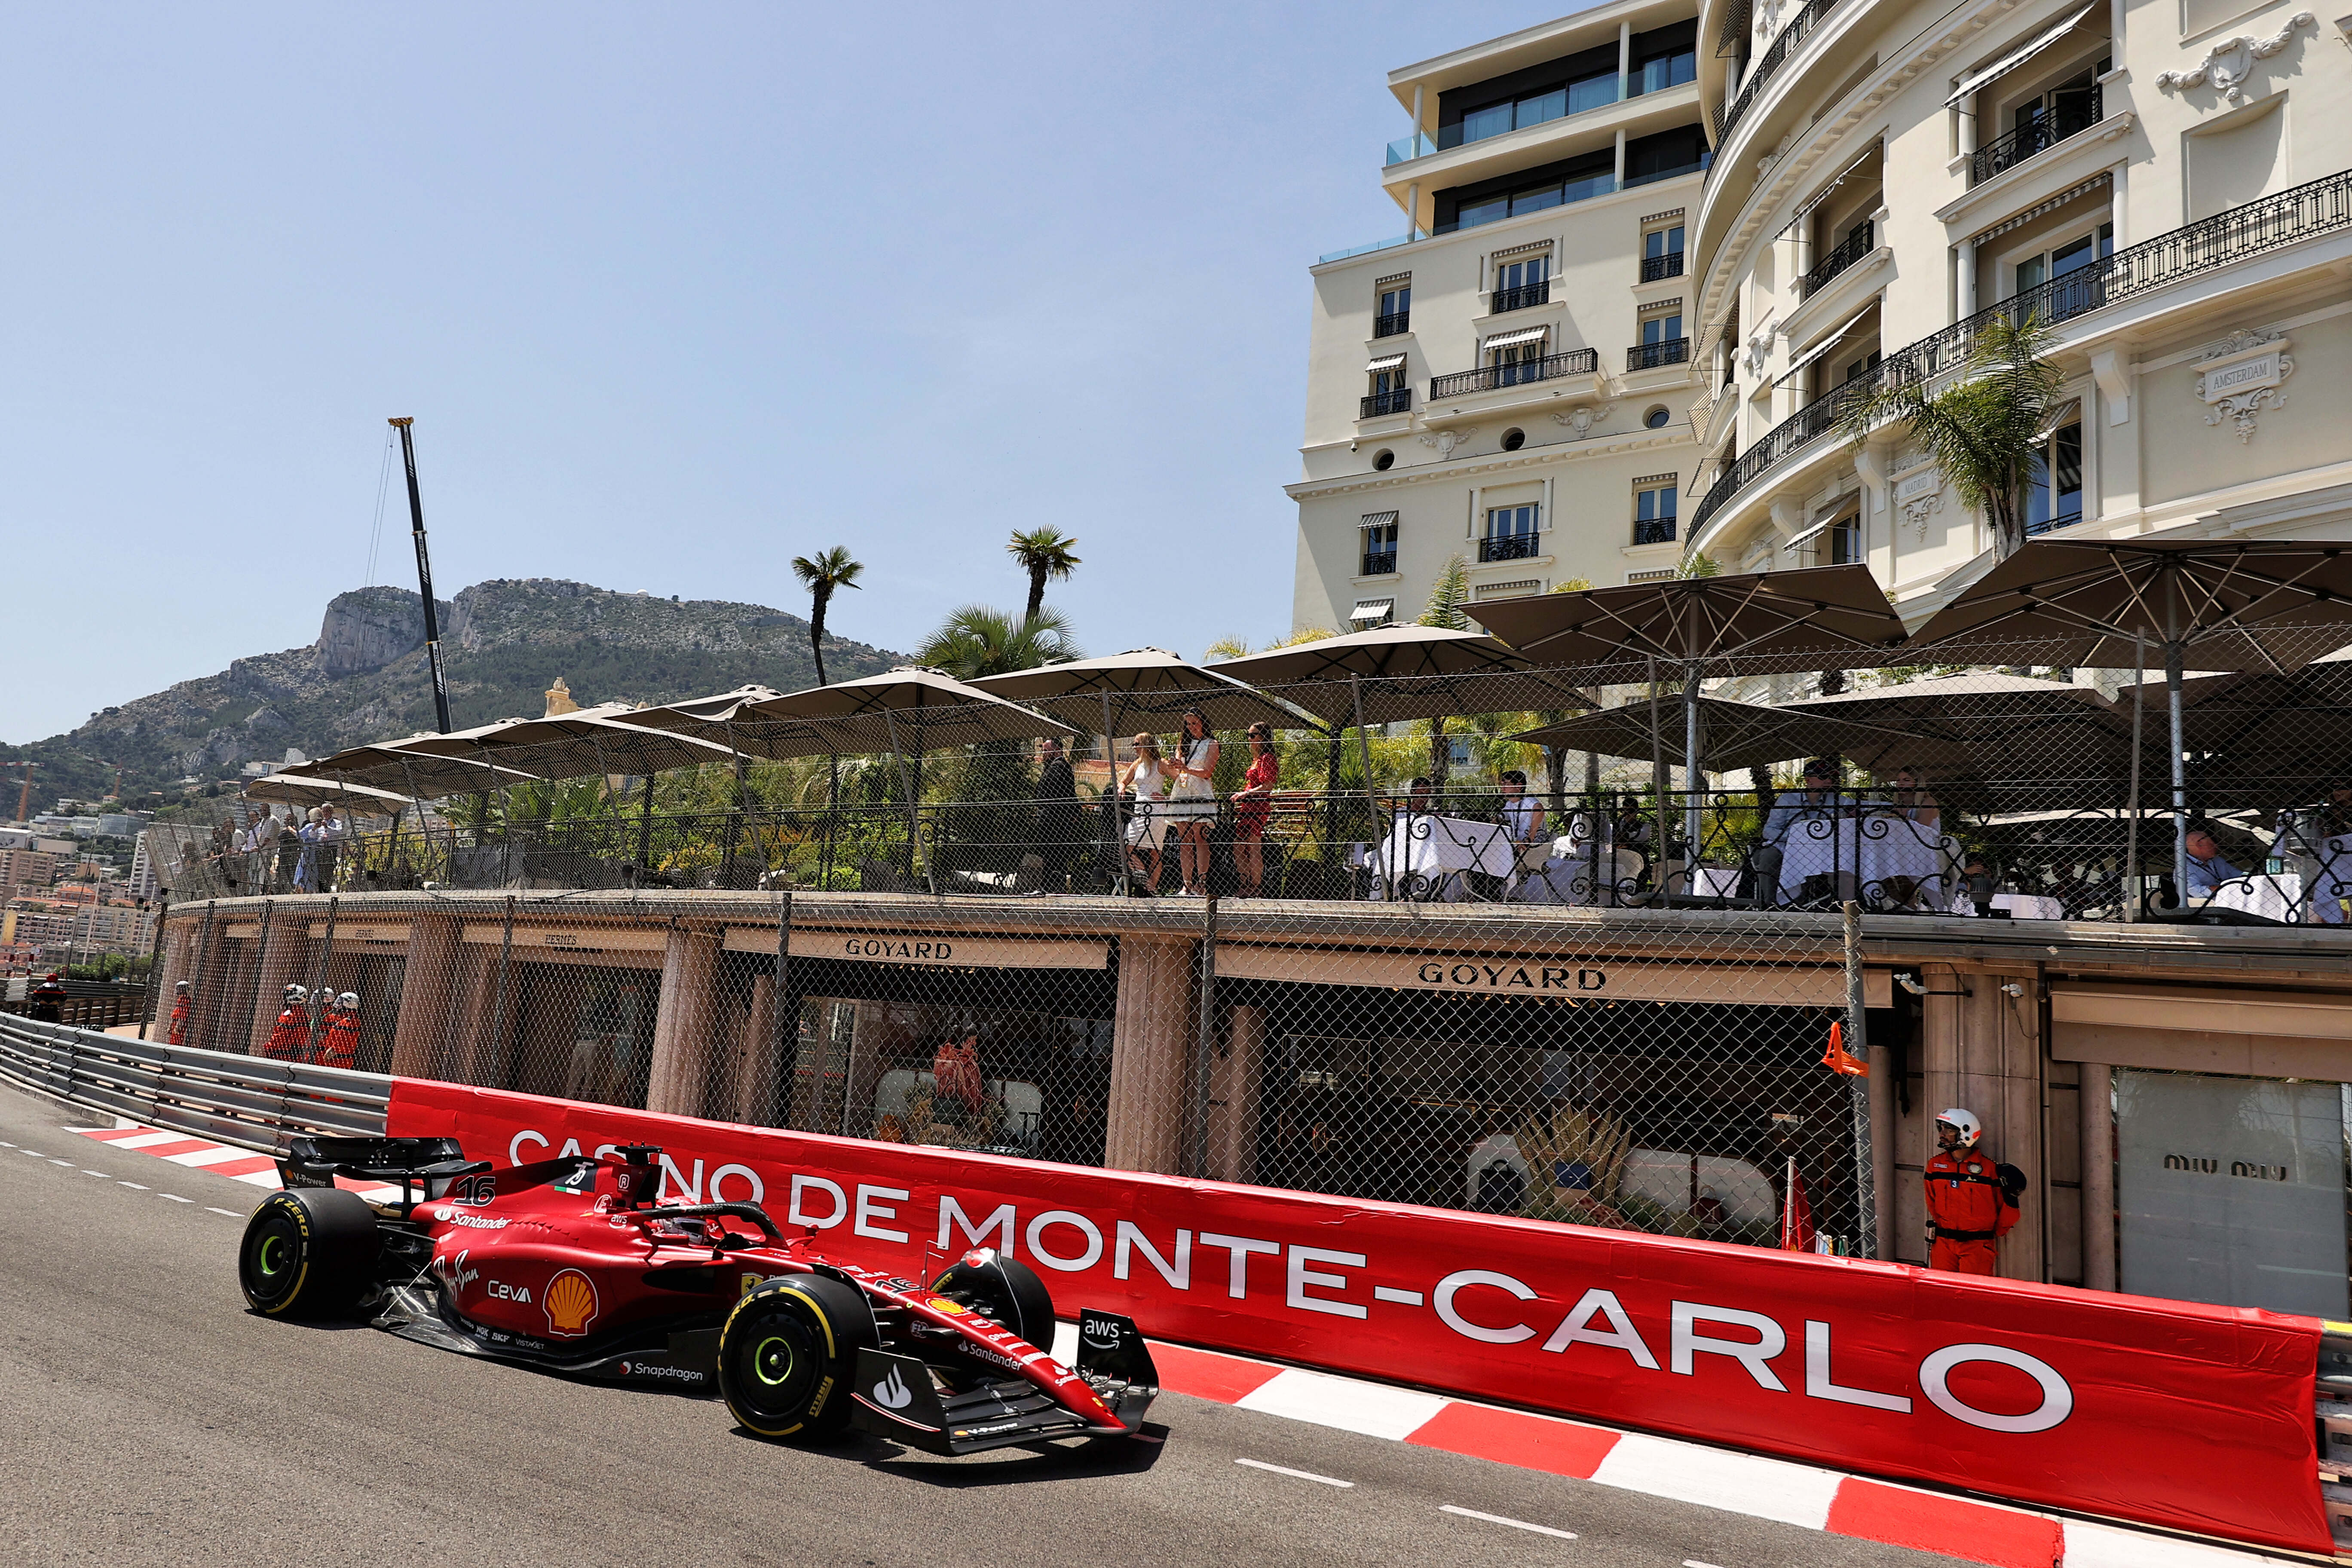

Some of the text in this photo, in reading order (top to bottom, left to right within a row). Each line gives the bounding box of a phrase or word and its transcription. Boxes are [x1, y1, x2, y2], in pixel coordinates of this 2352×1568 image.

[2214, 363, 2267, 389] AMSTERDAM
[1905, 477, 1927, 494] MADRID
[845, 939, 952, 959] GOYARD
[1418, 963, 1606, 990] GOYARD
[294, 1172, 326, 1187] V-Power
[451, 1176, 496, 1207] 16
[284, 1200, 309, 1237] ZERO
[450, 1211, 512, 1229] Santander
[611, 1214, 628, 1224] aws
[509, 1130, 2074, 1433] CANO DE MONTE-CARLO
[874, 1277, 925, 1298] 16
[492, 1332, 510, 1342] SKF
[1085, 1319, 1119, 1338] aws
[969, 1344, 1023, 1371] Santander
[635, 1363, 703, 1381] Snapdragon
[809, 1375, 834, 1417] PIRELLI
